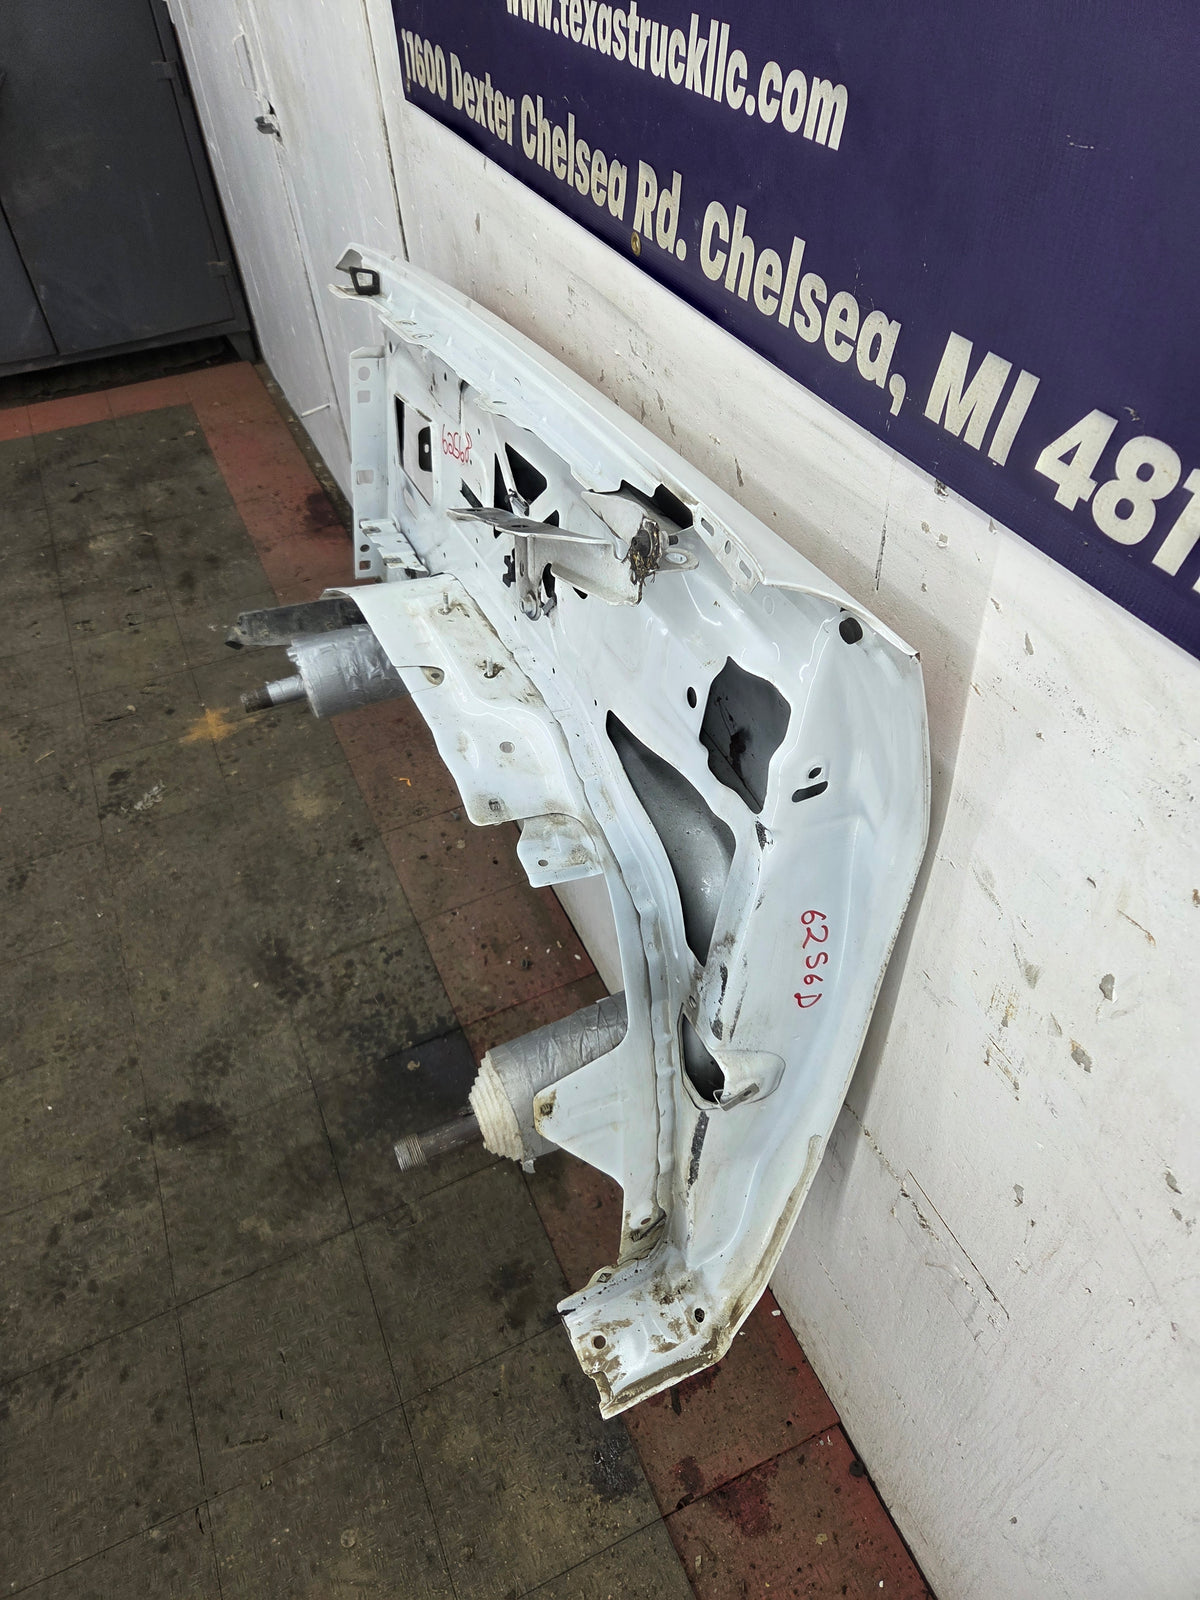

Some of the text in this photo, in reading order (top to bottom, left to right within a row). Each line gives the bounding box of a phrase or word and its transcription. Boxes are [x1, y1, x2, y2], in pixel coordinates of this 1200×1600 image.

[401, 28, 1200, 594] 11600 Dexter Chelsea Rd. Chelsea, MI 481
